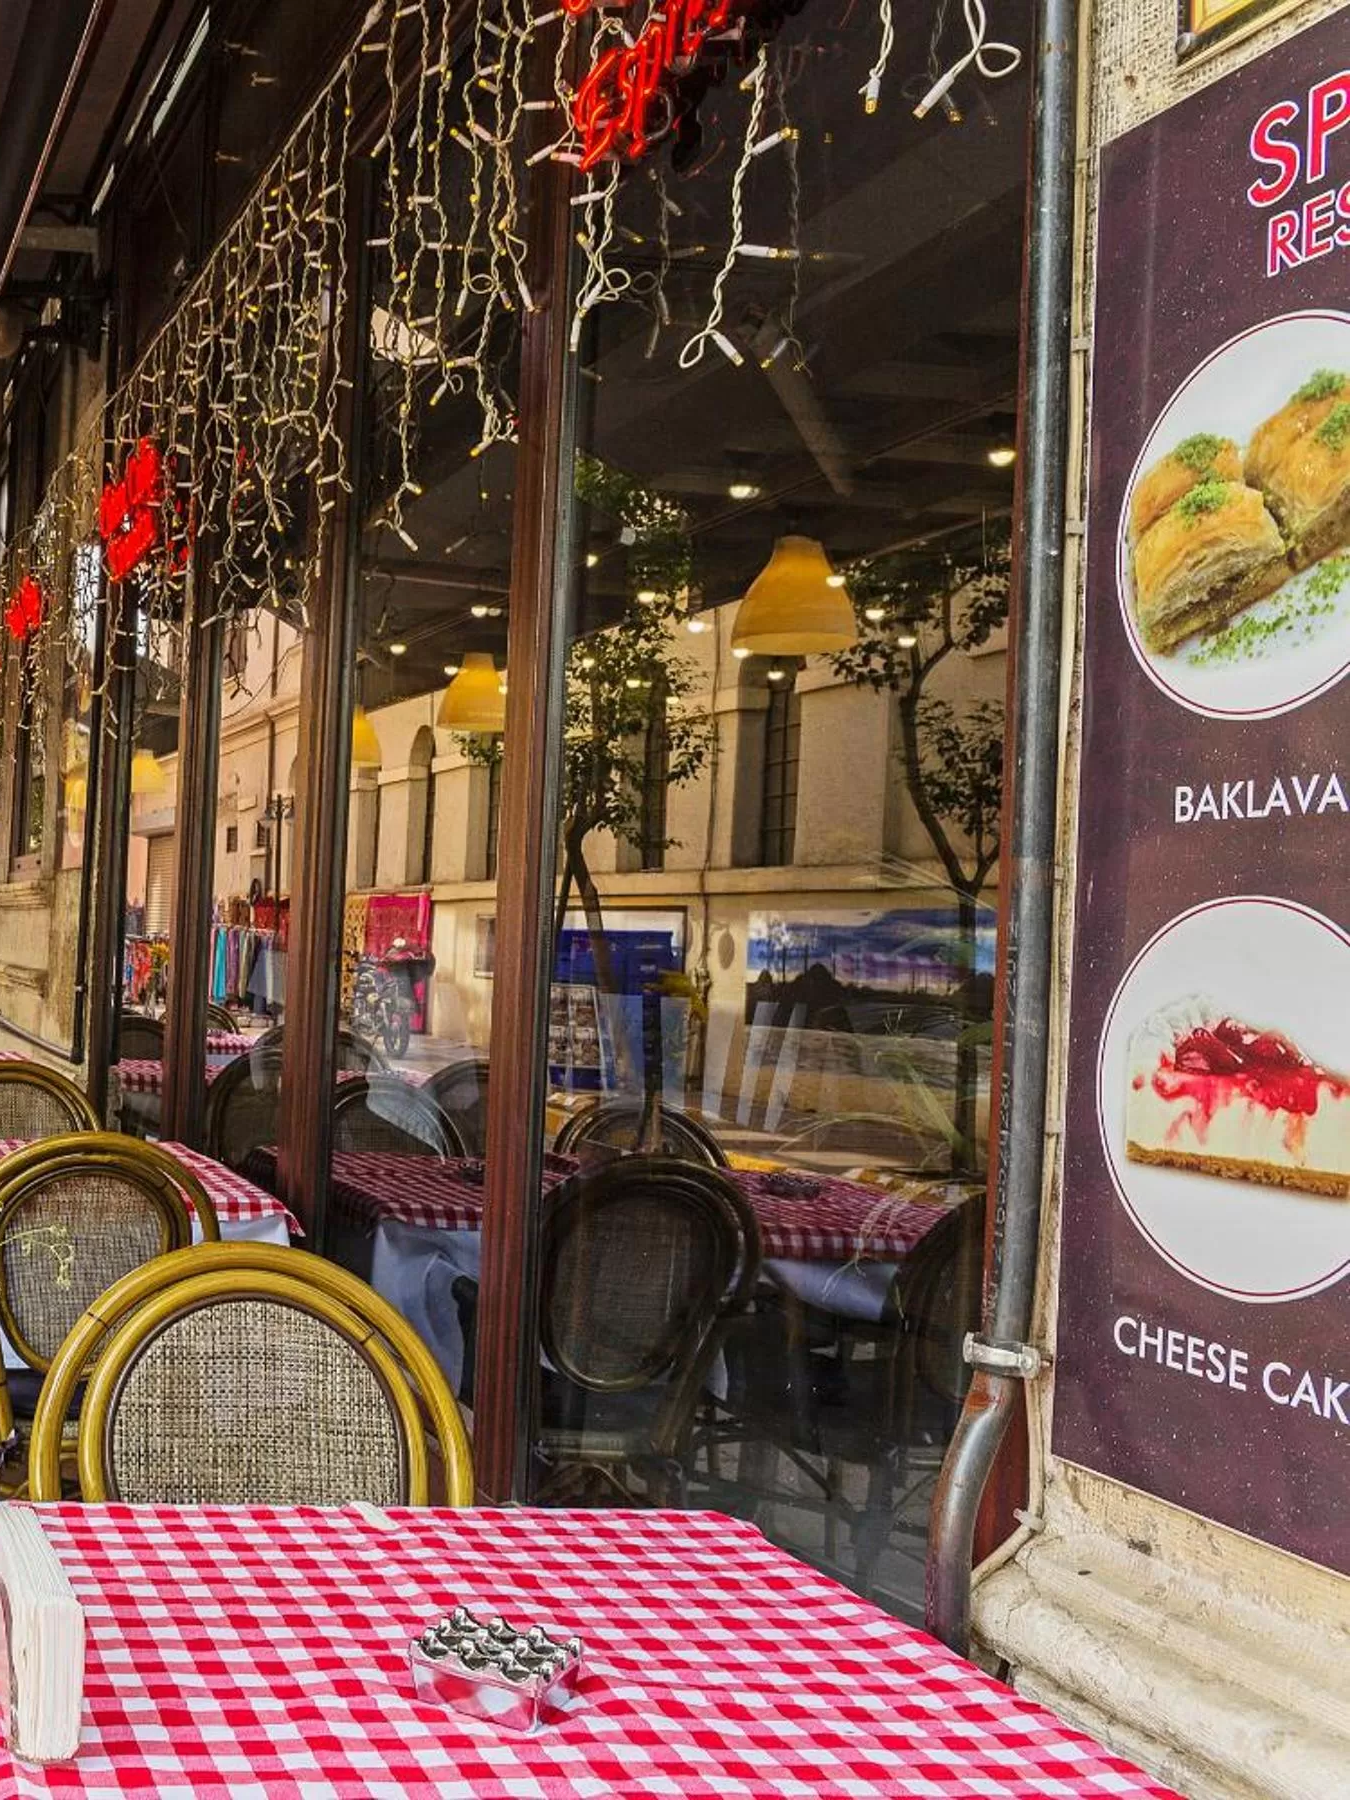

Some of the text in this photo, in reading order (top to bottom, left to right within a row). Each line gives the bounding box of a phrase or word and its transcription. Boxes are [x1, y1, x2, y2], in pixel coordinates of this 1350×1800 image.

[1174, 772, 1350, 824] BAKLAVA
[1113, 1315, 1350, 1426] CHEESE CAK
